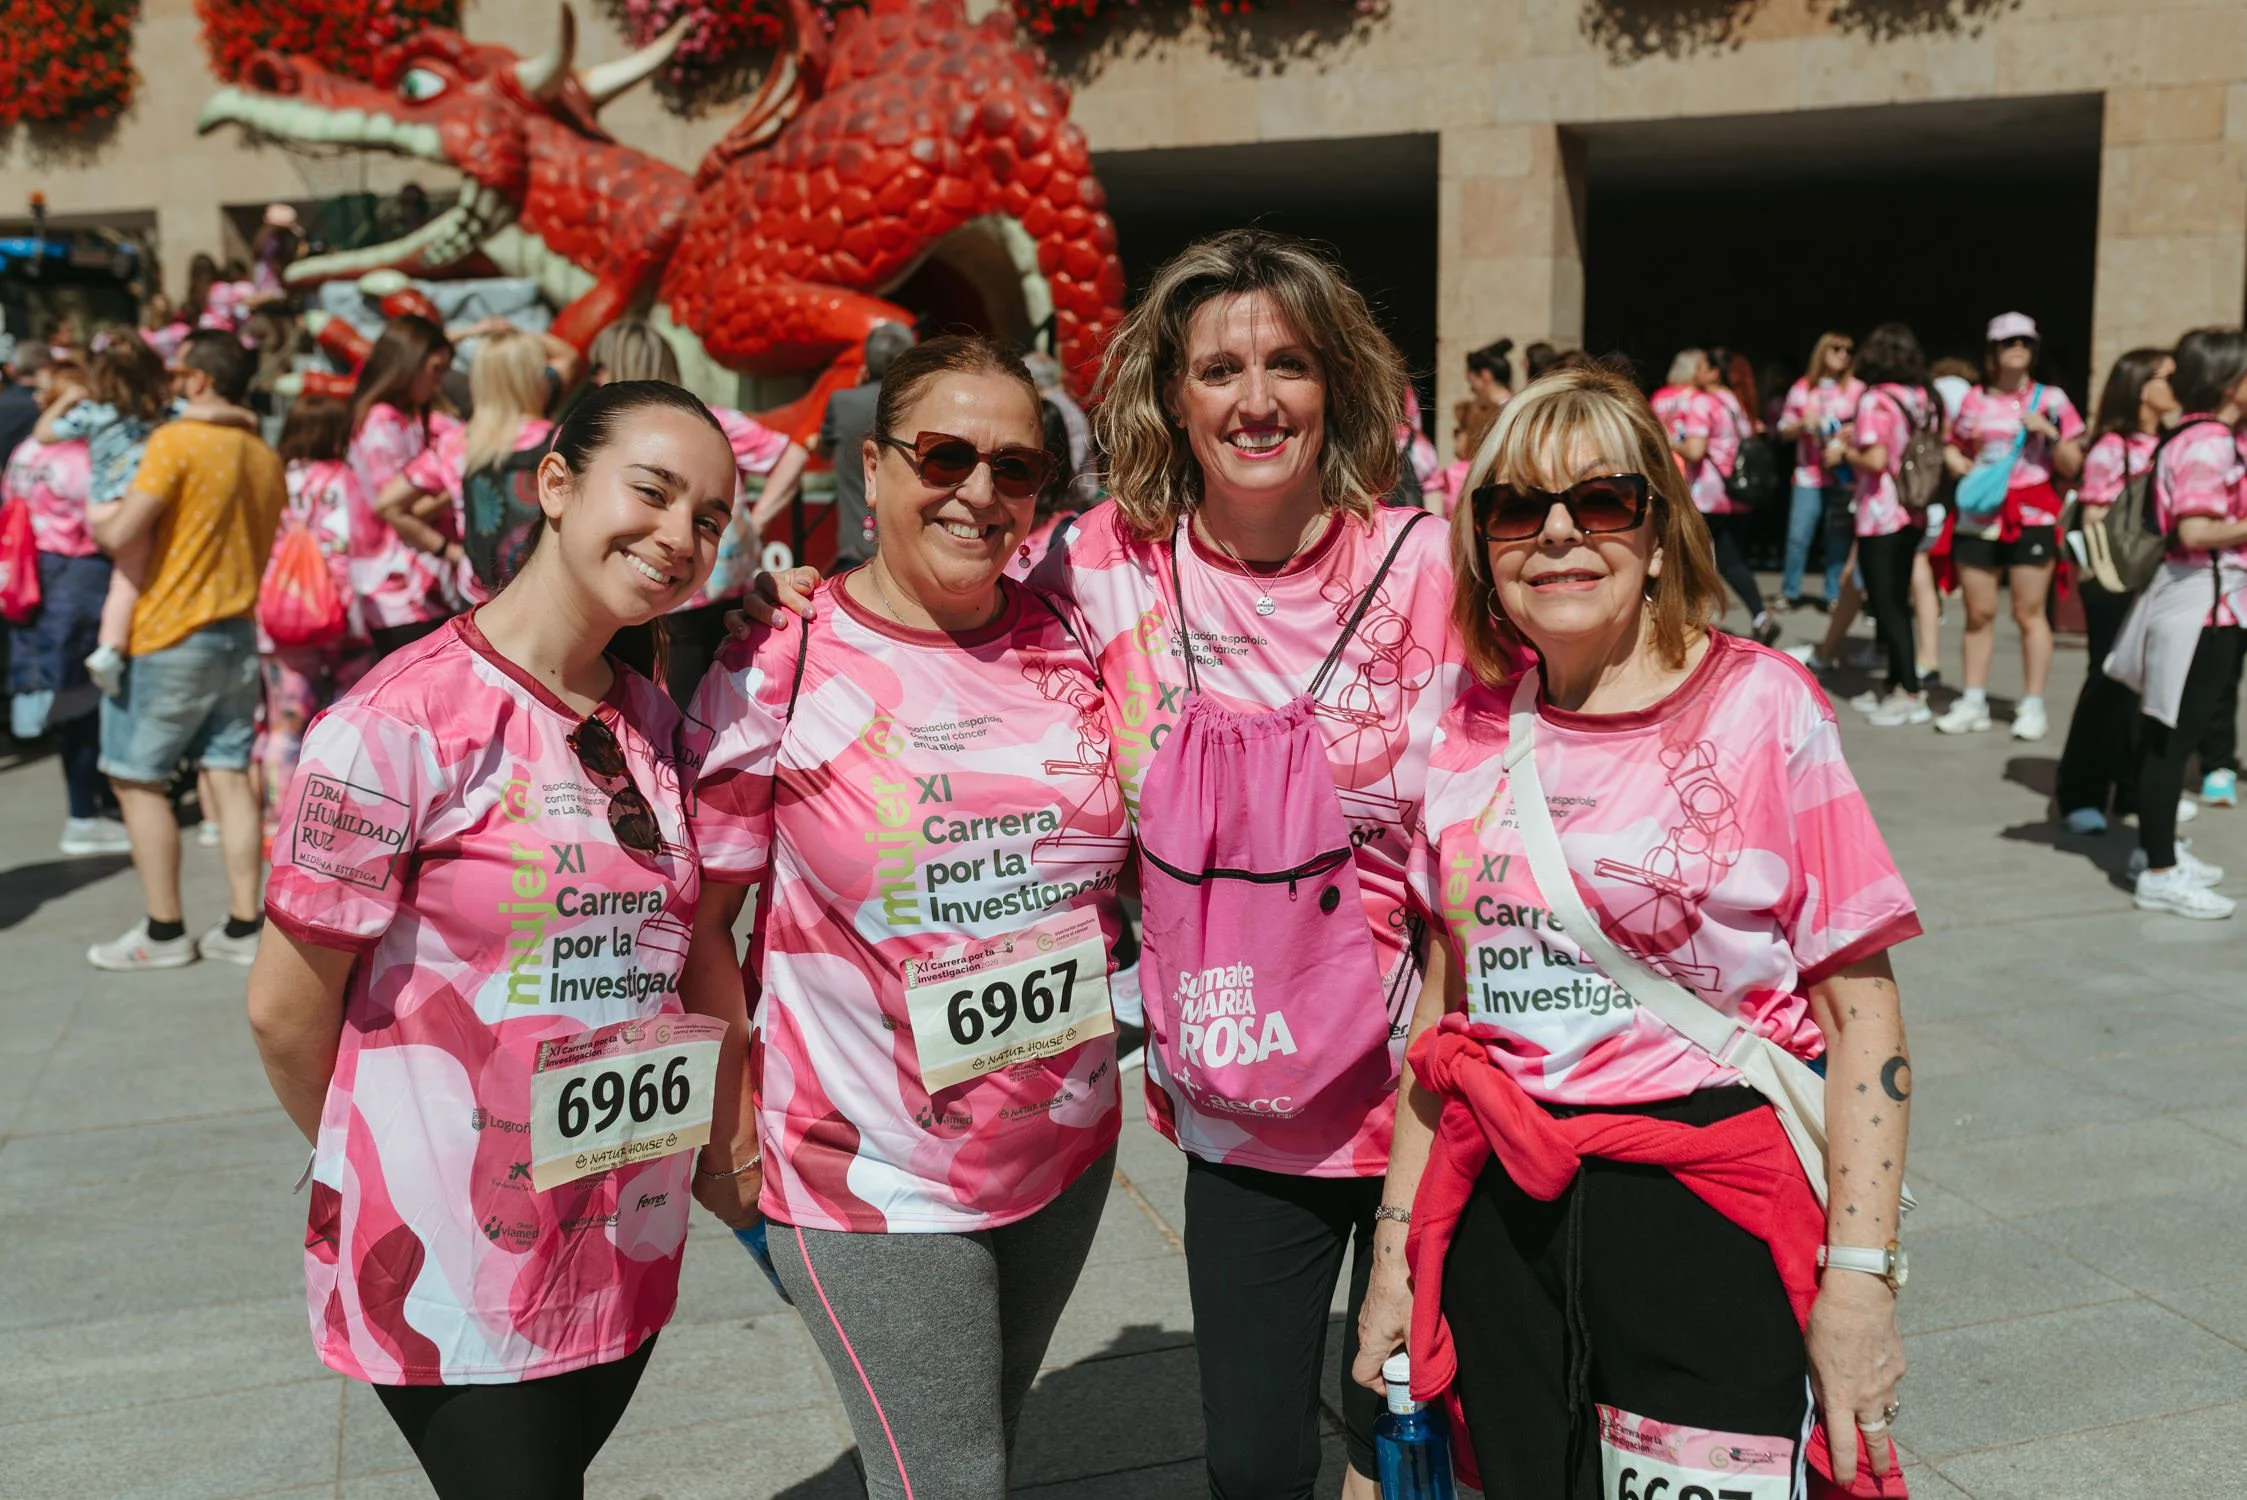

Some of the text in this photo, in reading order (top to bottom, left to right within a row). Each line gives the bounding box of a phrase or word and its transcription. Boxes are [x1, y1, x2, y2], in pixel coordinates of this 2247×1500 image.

[1171, 649, 1181, 657] en
[1202, 644, 1212, 653] el
[1214, 645, 1248, 656] cáncer
[1221, 634, 1267, 645] española
[914, 741, 965, 752] en La Rioja
[941, 733, 951, 741] el
[952, 728, 987, 740] cáncer
[545, 793, 576, 804] contra
[914, 774, 953, 804] XI
[304, 801, 402, 846] HUMILDAD
[548, 808, 560, 816] en
[562, 806, 576, 815] La
[922, 809, 1058, 844] Carrera
[551, 844, 586, 874] XI
[865, 776, 926, 926] mujer
[926, 849, 1026, 892] por la
[1475, 854, 1511, 883] XI
[556, 886, 663, 917] Carrera
[931, 868, 1118, 923] Investigación
[500, 842, 557, 1005] mujer
[1474, 896, 1565, 932] Carre
[553, 928, 632, 969] por la
[915, 948, 995, 974] XI Carrera por la
[1478, 941, 1576, 976] por la
[550, 966, 679, 1009] Investigac
[947, 959, 1078, 1045] 6967
[1481, 978, 1639, 1016] Investiga
[1181, 988, 1256, 1024] MAREA
[549, 1034, 618, 1057] XI Carrera por la
[987, 1046, 1025, 1066] NATUR
[1028, 1035, 1065, 1051] HOUSE
[1179, 1010, 1298, 1068] ROSA
[558, 1056, 691, 1138] 6966
[1208, 1094, 1293, 1113] aecc
[490, 1115, 531, 1134] Logroñ
[629, 1138, 664, 1154] HOUSE
[502, 1226, 538, 1239] viamed
[1641, 1433, 1653, 1443] por
[1654, 1436, 1663, 1445] la
